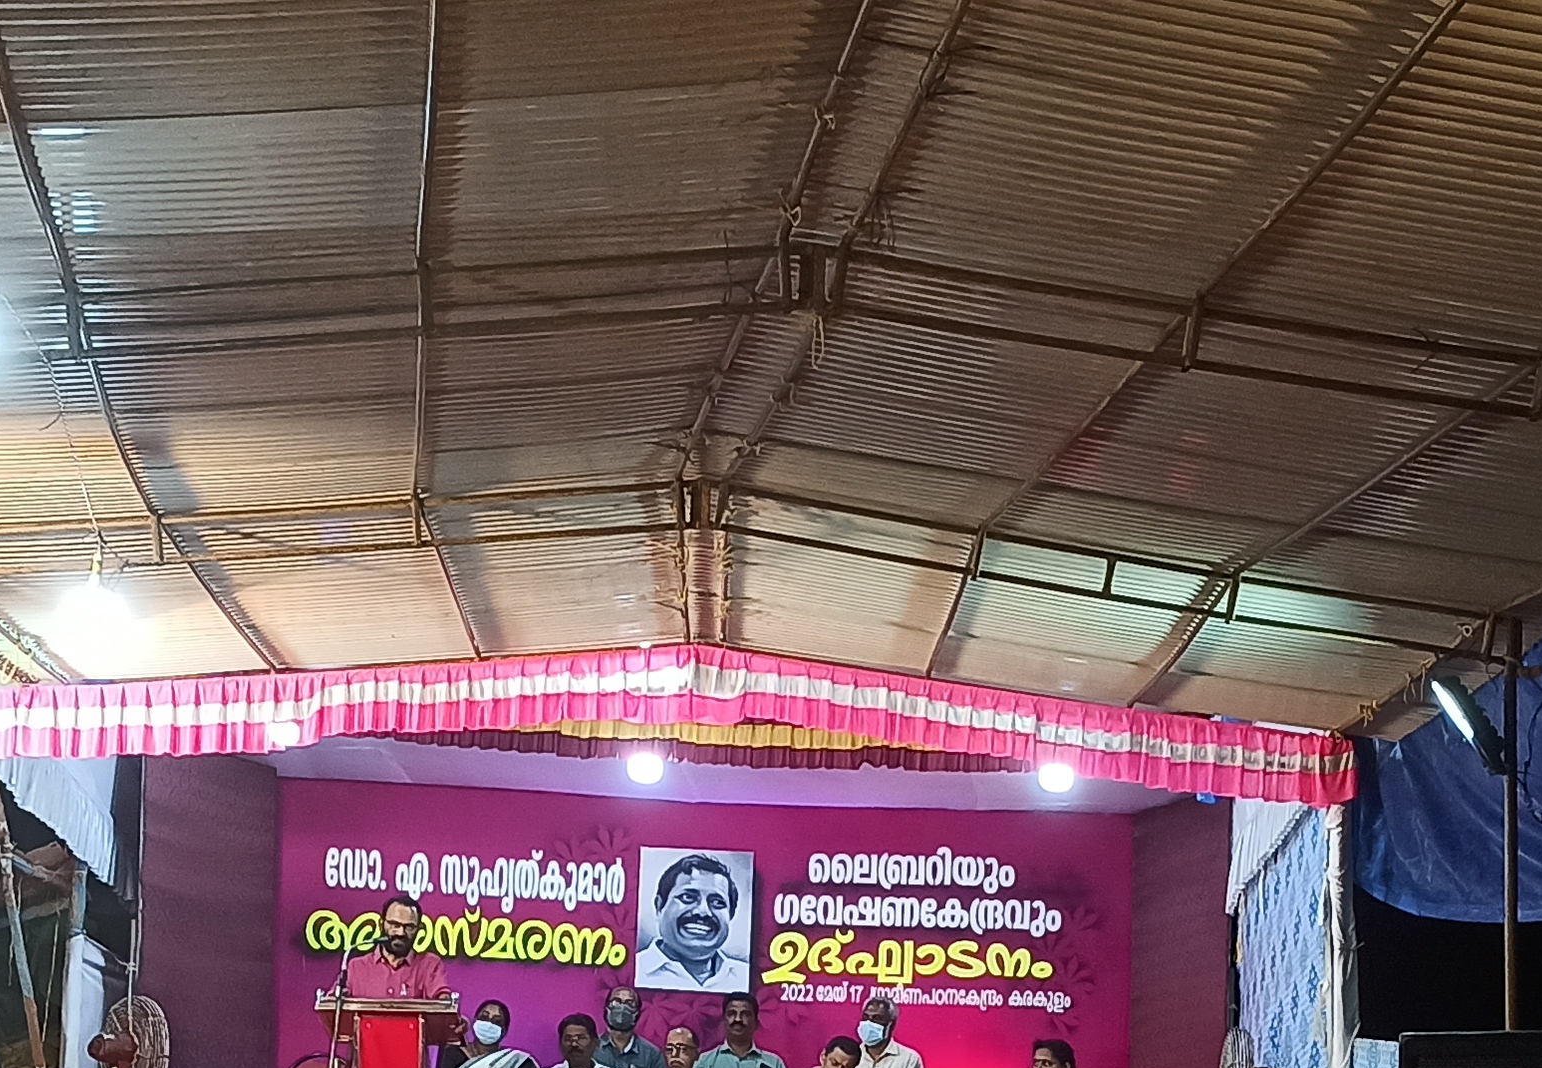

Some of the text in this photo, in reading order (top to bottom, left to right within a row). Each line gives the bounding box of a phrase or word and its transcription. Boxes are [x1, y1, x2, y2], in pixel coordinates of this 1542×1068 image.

[325, 847, 626, 913] ഡോ. എ. സുഹൃത്കുമാർ
[808, 846, 1015, 894] ലൈബ്രറിയും
[305, 905, 627, 967] അസ്മരണം
[773, 893, 1062, 938] ഗവേഷണകേന്ദ്രവും
[761, 929, 1054, 984] ഉദ്ഘാടനം
[780, 982, 814, 1002] 2022
[815, 980, 849, 1003] മേയ്
[849, 985, 864, 1003] 17
[1008, 989, 1072, 1013] കരകുളം
